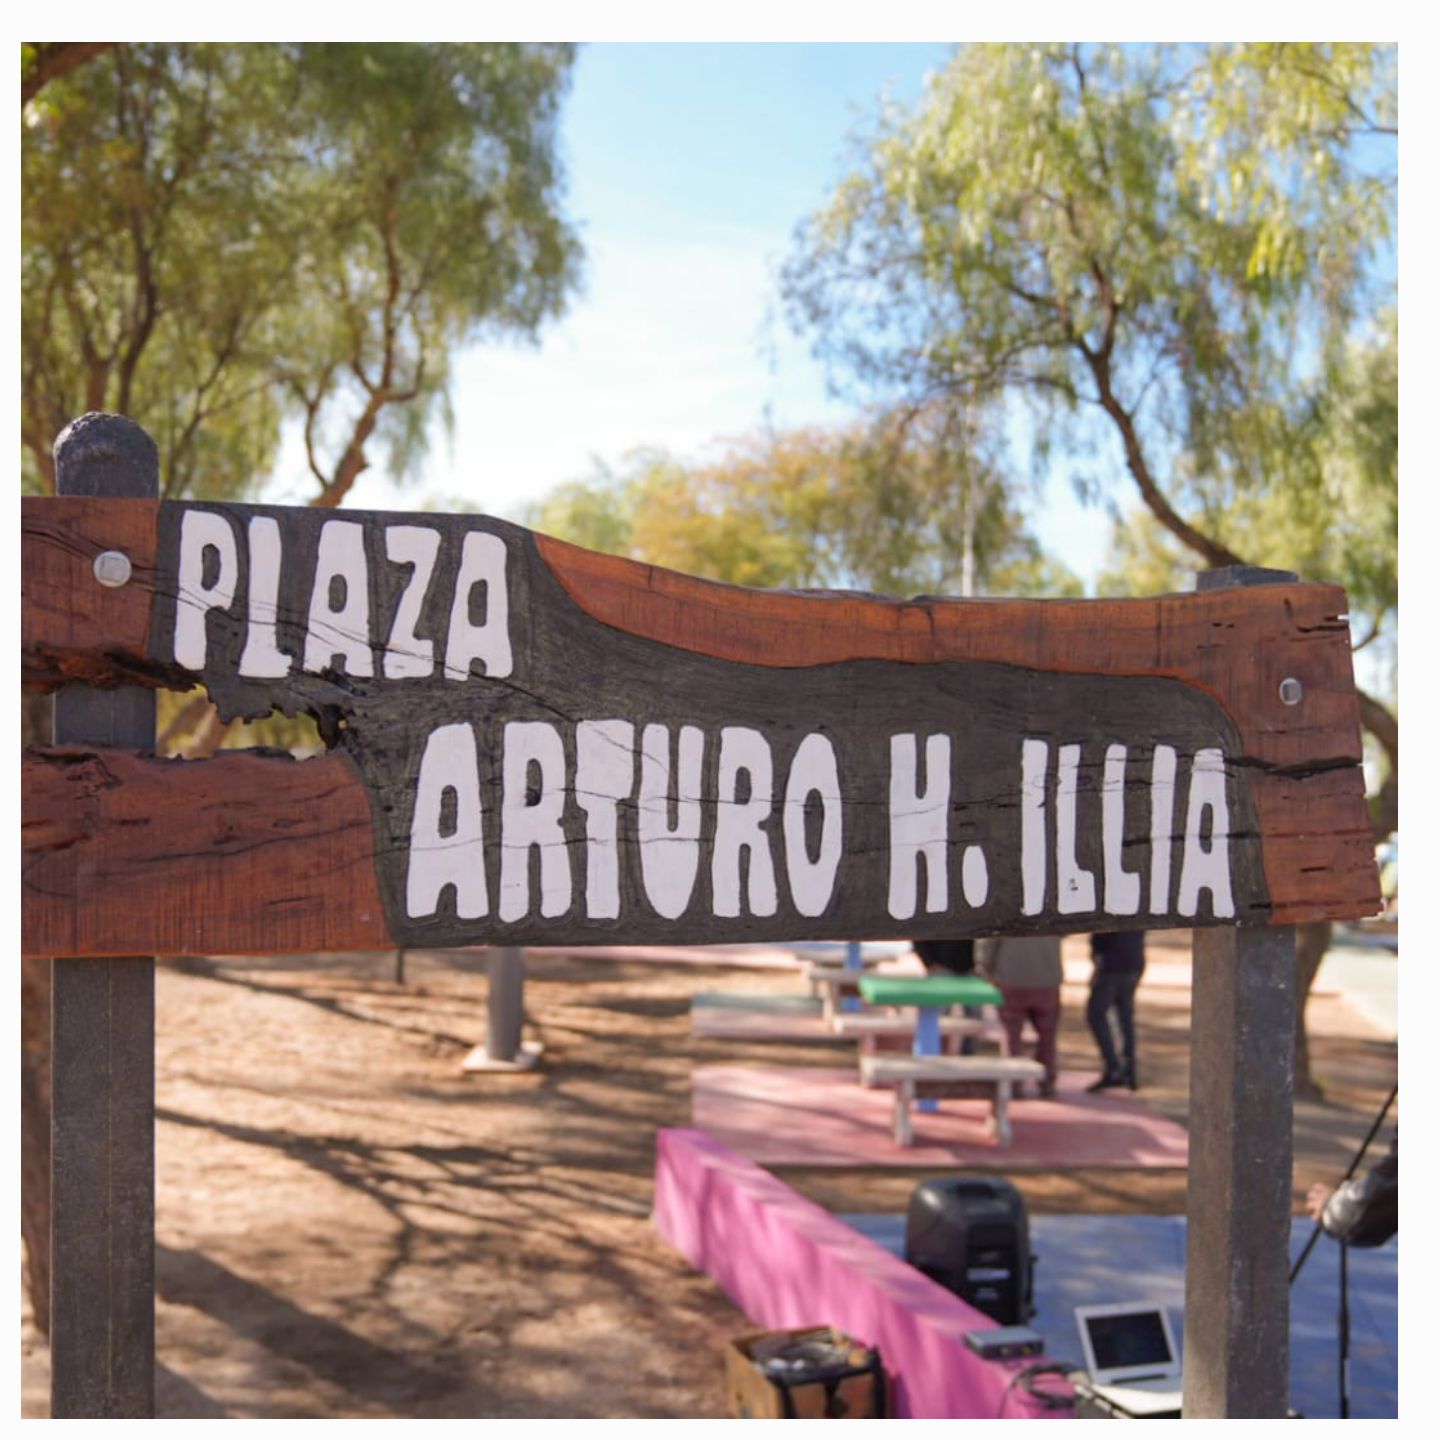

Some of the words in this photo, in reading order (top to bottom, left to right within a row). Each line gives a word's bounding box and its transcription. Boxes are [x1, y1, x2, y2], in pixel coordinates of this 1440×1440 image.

[175, 510, 513, 679] PLAZA
[407, 720, 842, 922] ARTURO
[888, 733, 988, 920] H.
[1021, 740, 1234, 919] ILLIA
